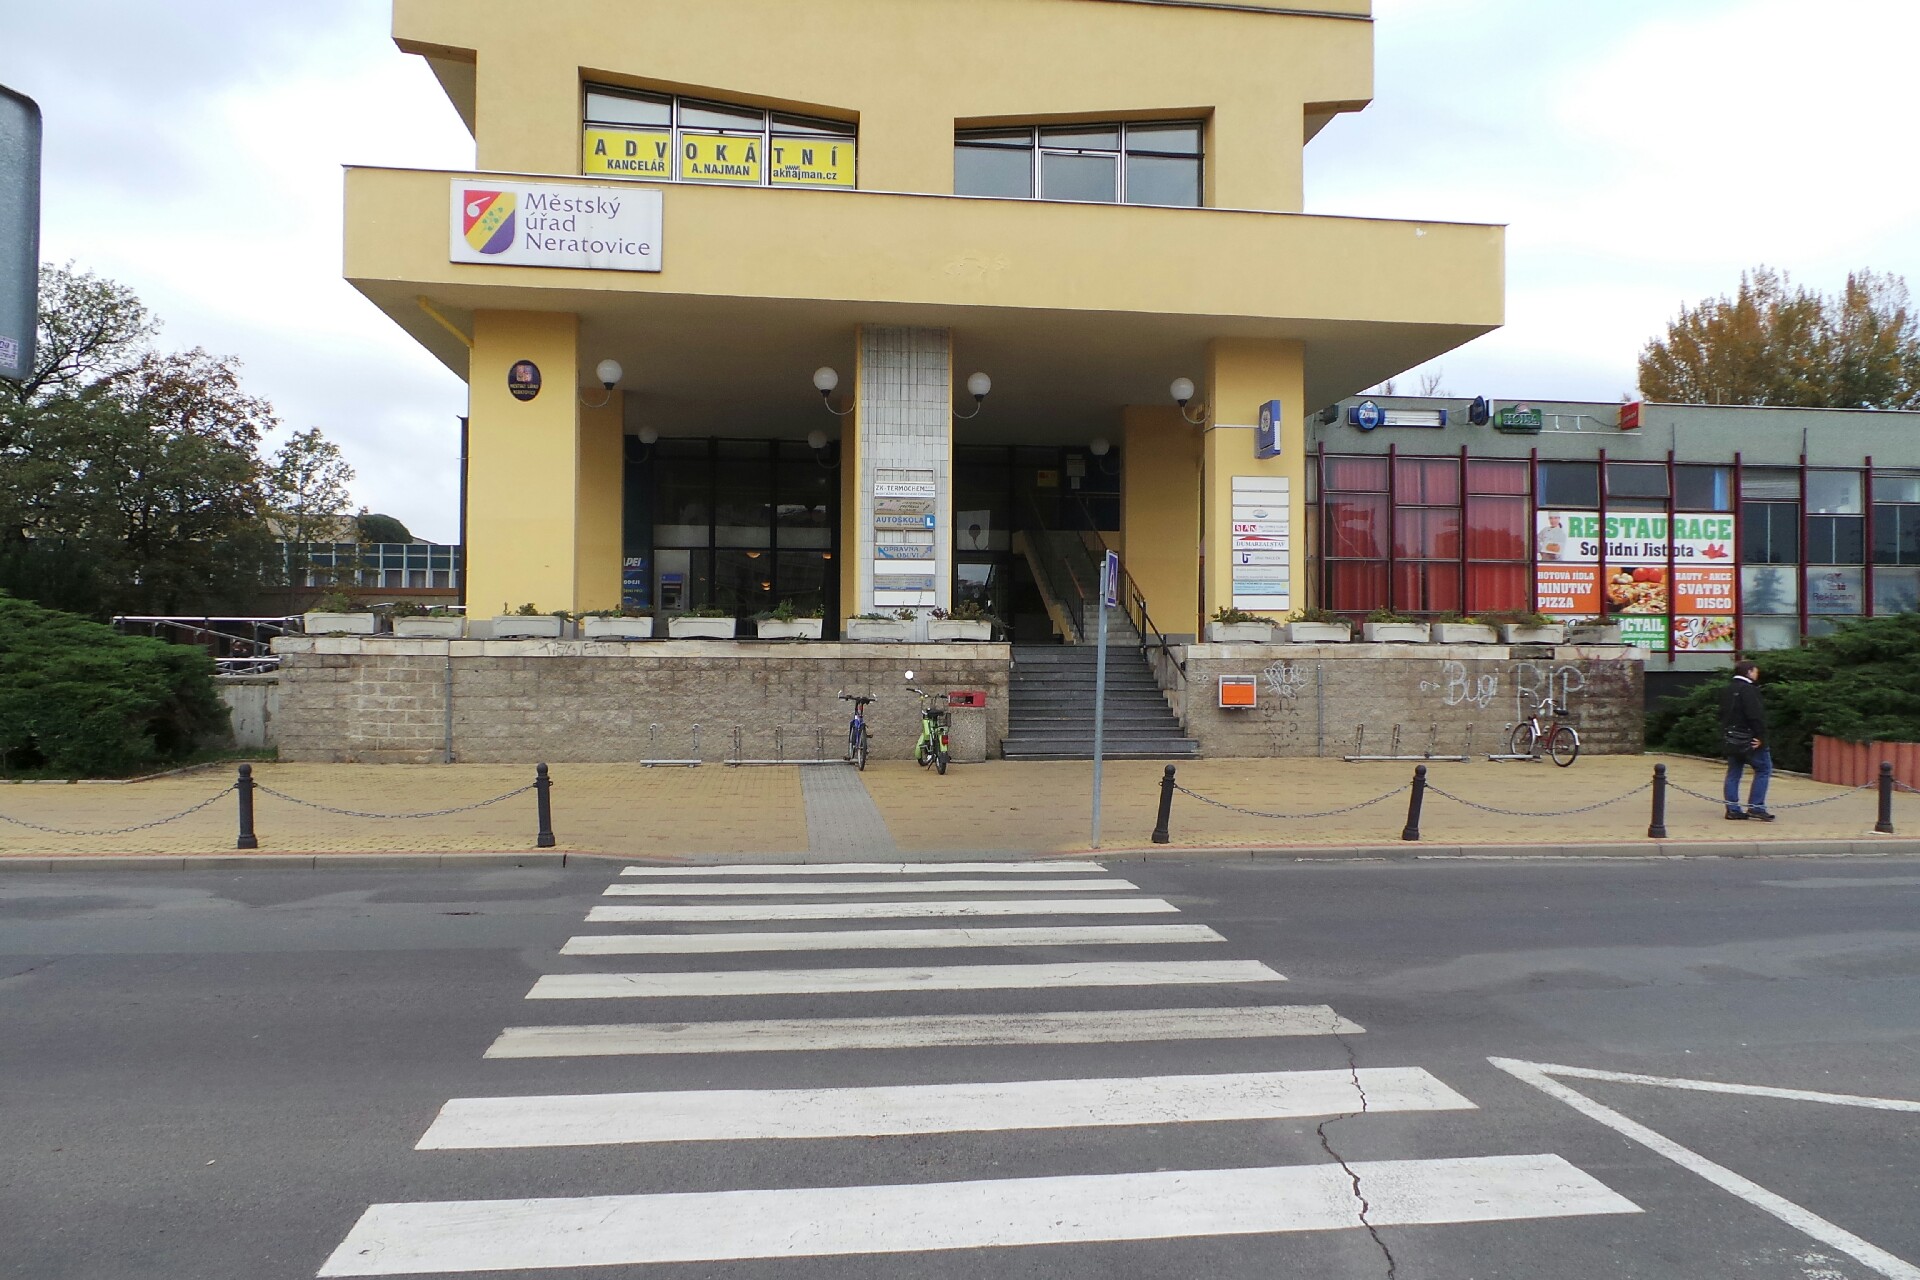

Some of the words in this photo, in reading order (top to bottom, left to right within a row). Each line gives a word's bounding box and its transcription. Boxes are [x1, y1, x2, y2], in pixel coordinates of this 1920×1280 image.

[594, 138, 838, 167] ADVOKÁTNÍ
[607, 158, 665, 172] KANCELÁŘ
[691, 162, 750, 176] A.NAJMAN
[772, 168, 837, 181] aknajman.cz
[525, 193, 621, 219] Městský
[526, 212, 576, 232] úřad
[526, 233, 650, 255] Neratovice
[1568, 516, 1731, 540] RESTAURACE
[1580, 541, 1638, 556] Solidní
[1643, 542, 1694, 558] Jistota
[1537, 571, 1570, 580] HOTOVÁ
[1572, 571, 1594, 581] JÍDLA
[1709, 572, 1732, 581] AKCE
[1537, 582, 1593, 594] MINUTKY
[1678, 583, 1731, 595] SVATBY
[1537, 596, 1574, 608] PIZZA
[1696, 597, 1732, 609] DISCO
[1443, 660, 1498, 708] Bugi
